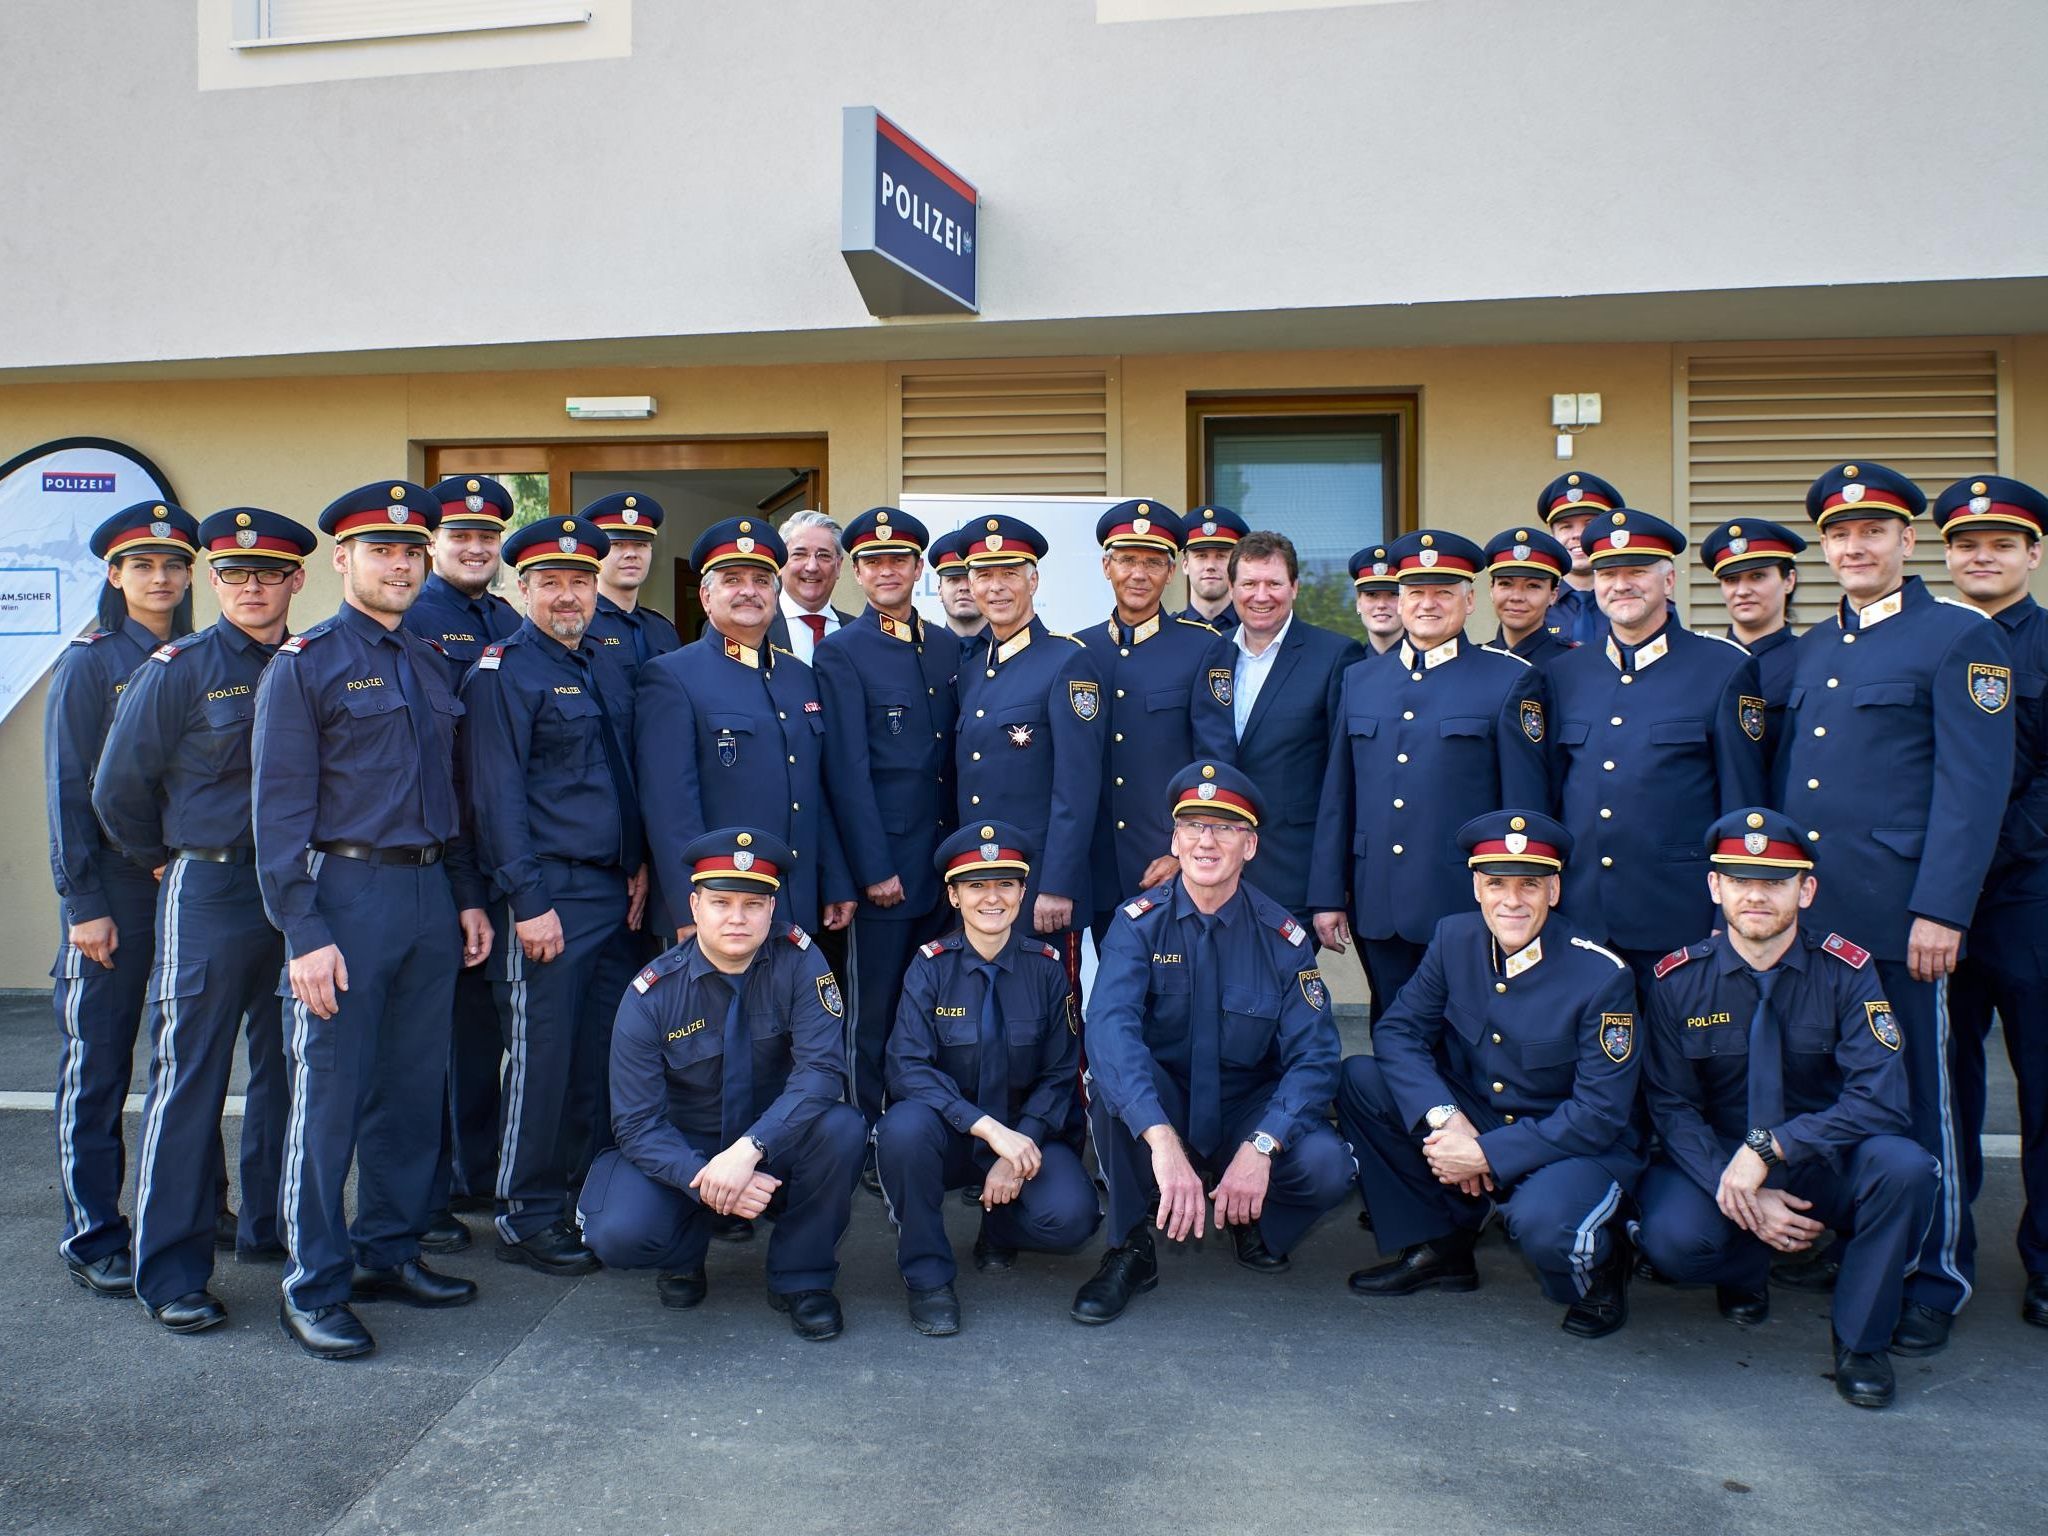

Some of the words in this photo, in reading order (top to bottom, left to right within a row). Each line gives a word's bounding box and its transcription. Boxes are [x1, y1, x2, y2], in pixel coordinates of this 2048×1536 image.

[882, 172, 961, 256] POLIZEI
[46, 479, 102, 489] POLIZEI
[442, 634, 475, 642] POLIZEI
[347, 677, 384, 691] POLIZEI
[554, 686, 581, 694] POLIZEI
[208, 685, 250, 701] POLIZEI
[936, 1007, 966, 1016] OLIZEI
[1688, 1012, 1730, 1027] POLIZEI
[668, 1018, 706, 1041] POLIZEI
